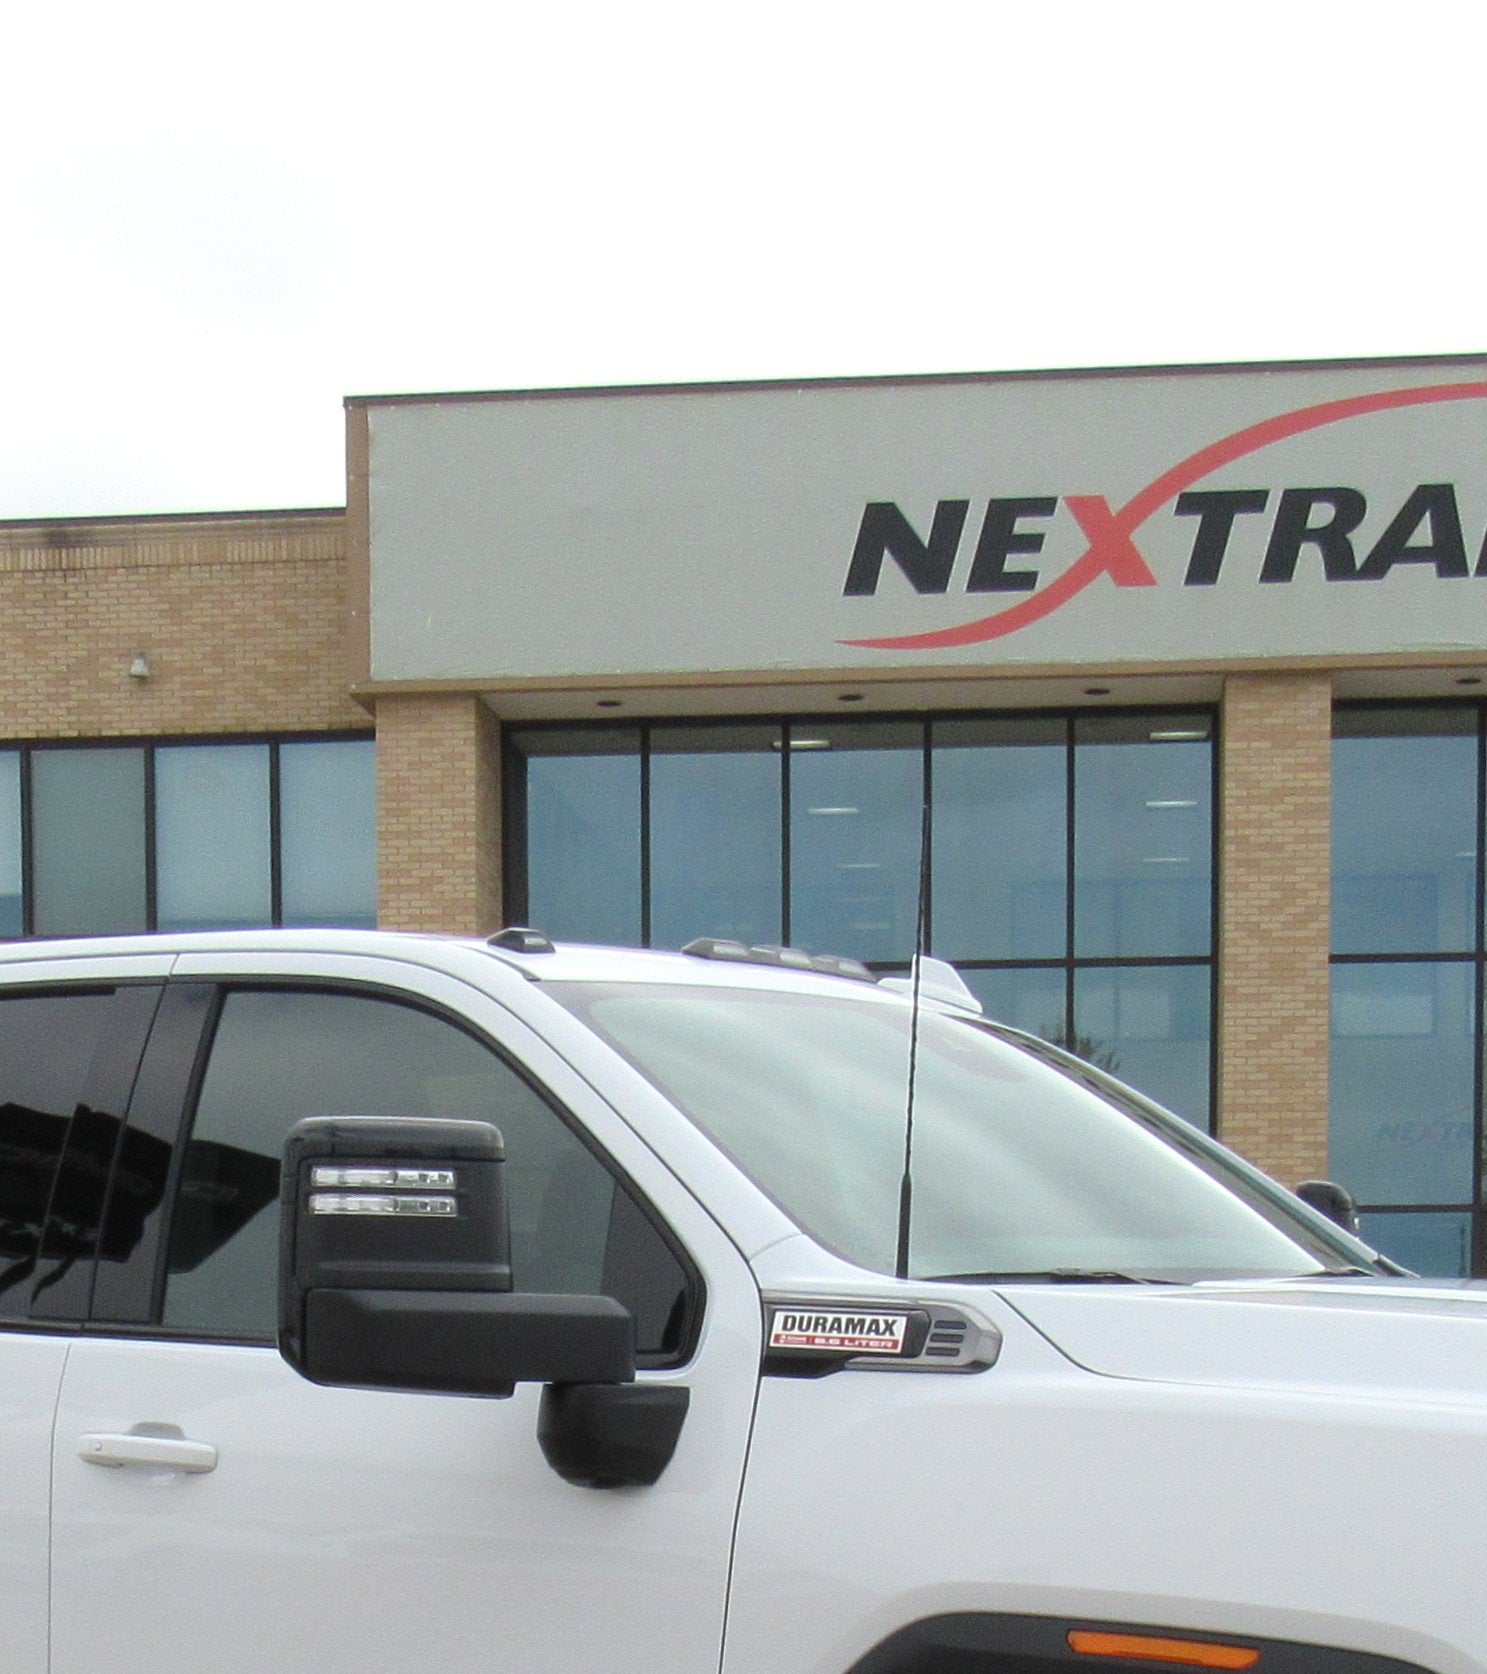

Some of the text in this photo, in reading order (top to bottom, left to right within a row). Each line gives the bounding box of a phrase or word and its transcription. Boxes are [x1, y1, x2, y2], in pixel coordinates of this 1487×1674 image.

[781, 1314, 898, 1337] DURAMAX
[814, 1337, 841, 1345] 6.6
[844, 1339, 894, 1349] LITER
